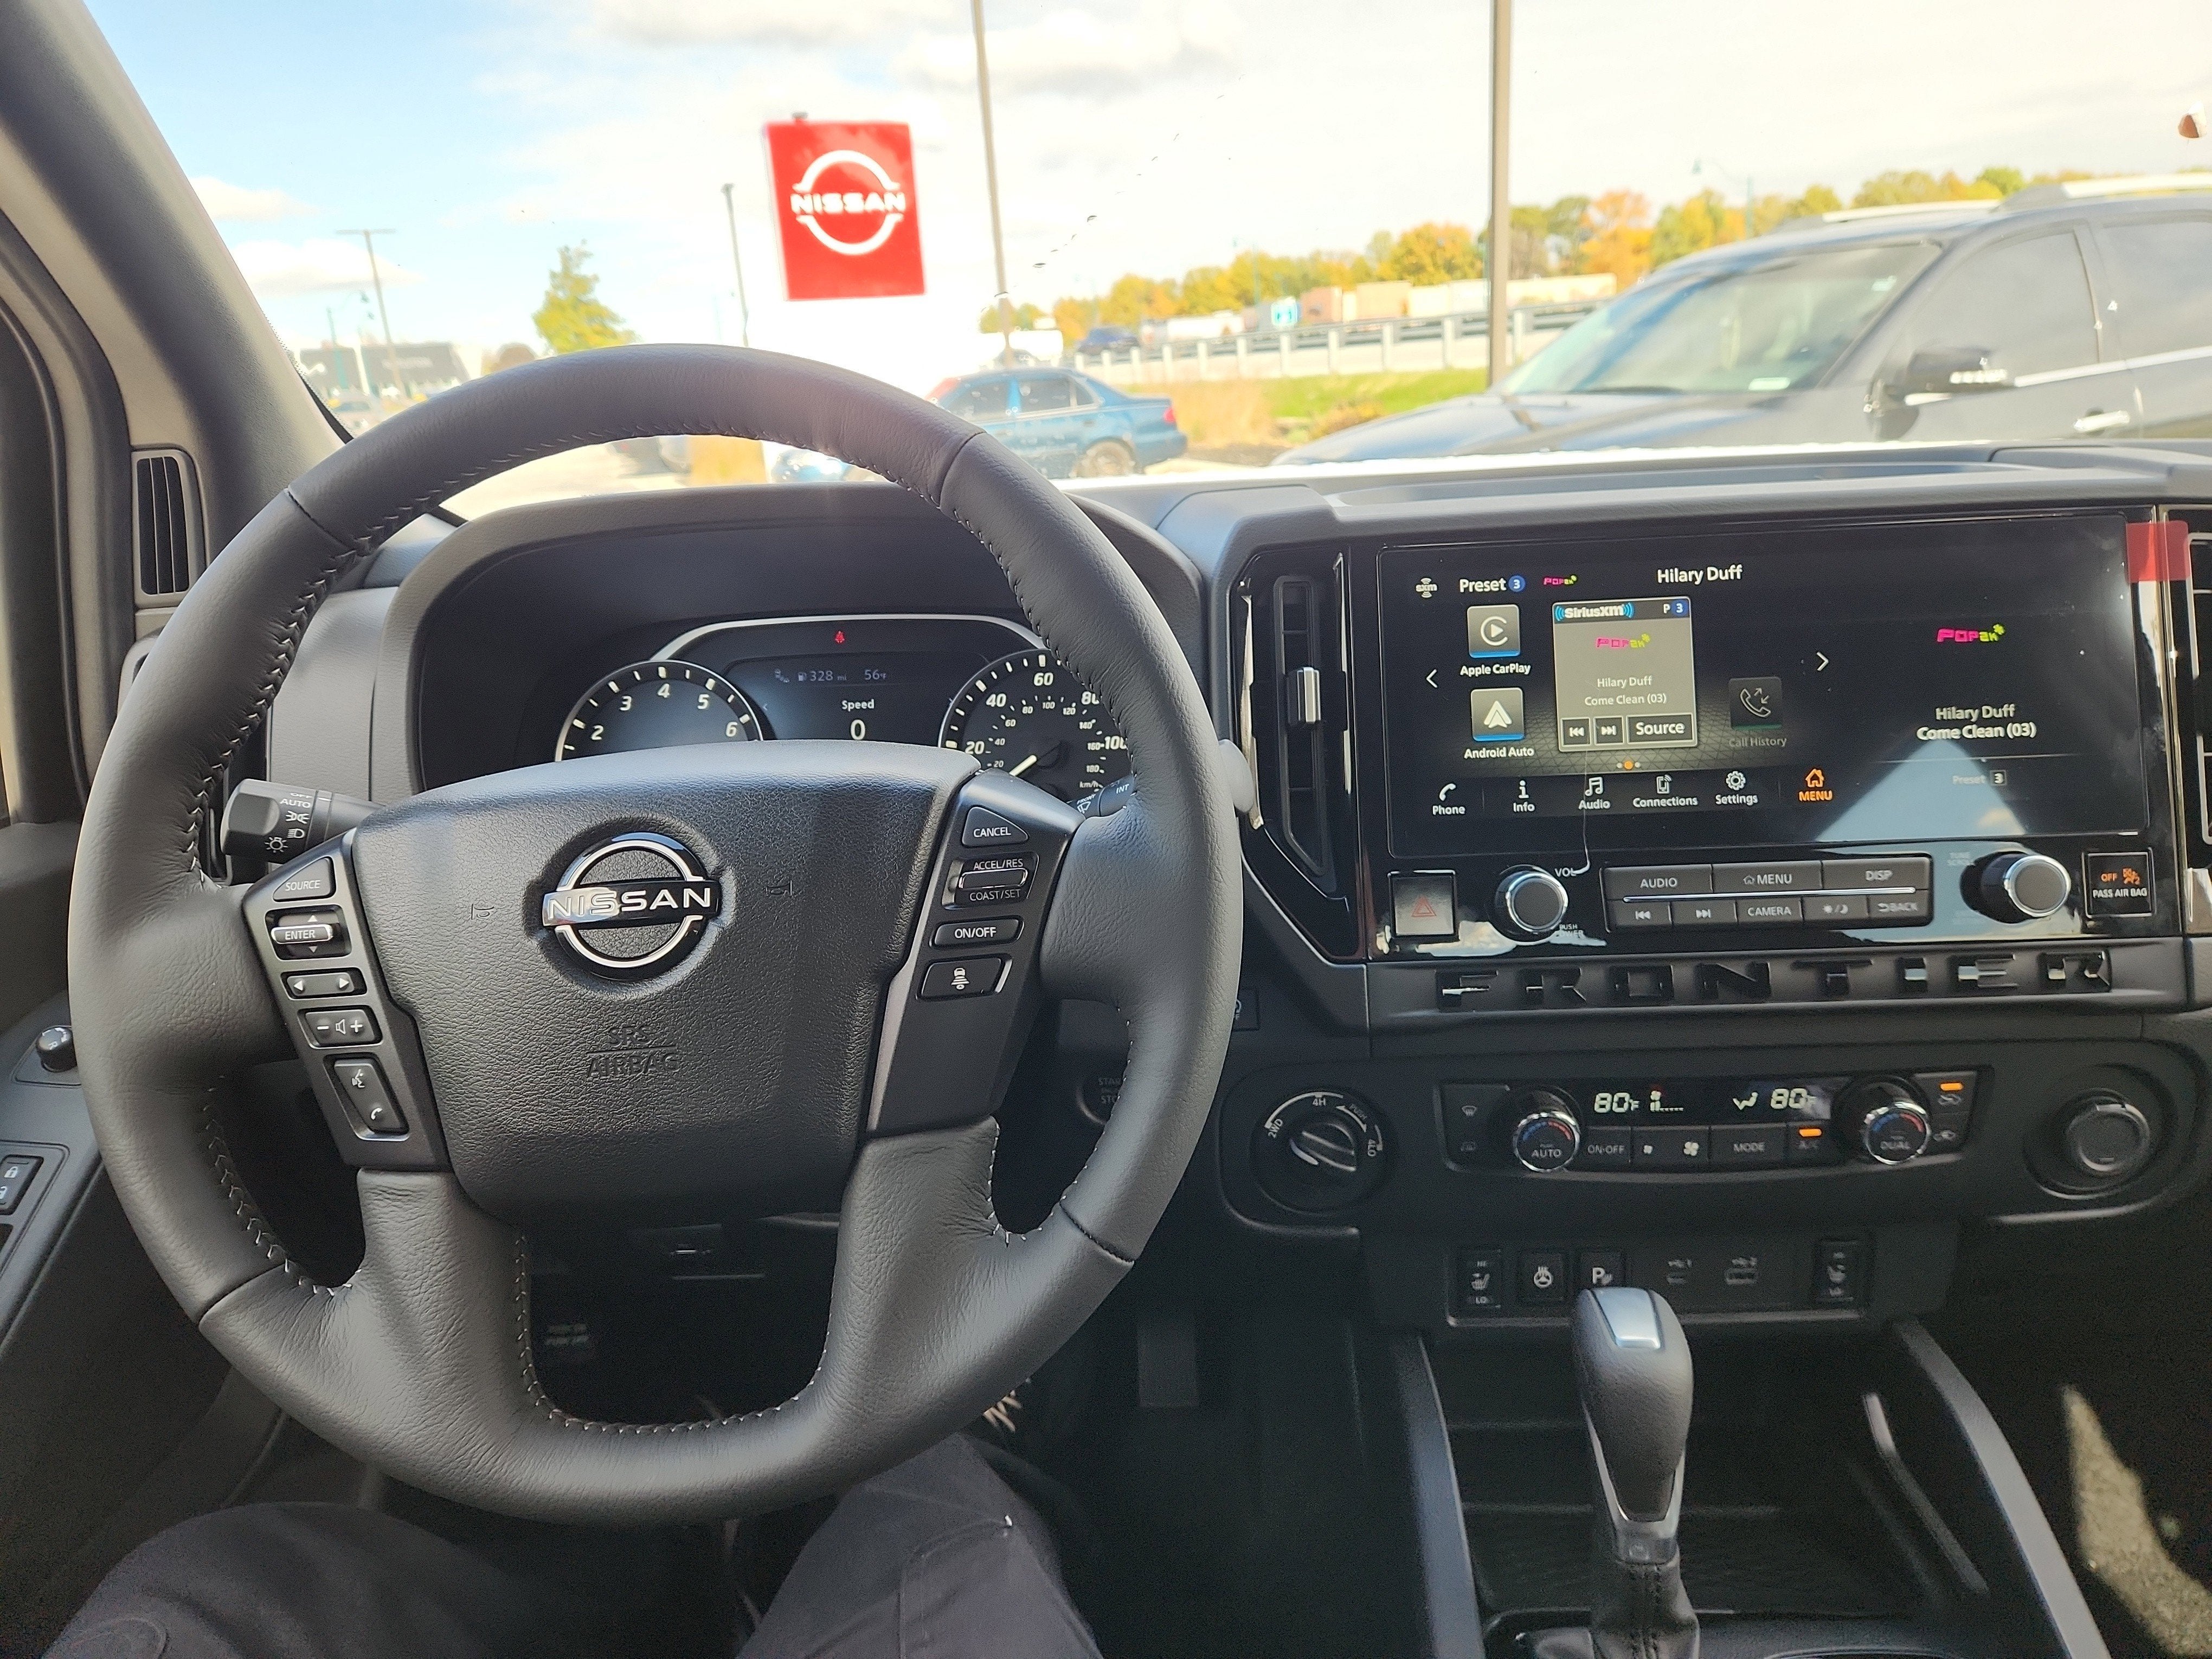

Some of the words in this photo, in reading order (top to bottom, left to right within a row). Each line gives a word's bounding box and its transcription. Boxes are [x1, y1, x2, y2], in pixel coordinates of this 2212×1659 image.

[790, 192, 905, 214] NISSAN
[1657, 567, 1703, 585] Hilary
[1707, 564, 1742, 581] Duff
[1459, 578, 1506, 593] Preset
[1663, 603, 1670, 614] P
[810, 670, 833, 681] 328
[1460, 664, 1491, 677] Apple
[1493, 663, 1531, 675] CarPlay
[1033, 672, 1053, 686] 60
[1597, 678, 1626, 689] Hilary
[1629, 675, 1652, 686] Duff
[657, 683, 670, 698] 4
[620, 696, 632, 711] 3
[697, 693, 710, 710] 5
[841, 698, 874, 712] Speed
[986, 693, 1007, 708] 40
[1042, 701, 1056, 709] 100
[1585, 697, 1613, 705] Come
[1616, 695, 1645, 704] Clean
[1647, 693, 1667, 704] (03)
[1063, 707, 1076, 715] 120
[1935, 708, 1978, 722] Hilary
[1982, 704, 2015, 718] Duff
[1005, 719, 1016, 727] 60
[1636, 722, 1685, 736] Source
[591, 724, 604, 741] 2
[725, 721, 737, 738] 6
[850, 719, 866, 741] 0
[1917, 727, 1962, 740] Come
[1963, 725, 2004, 739] Clean
[2007, 723, 2037, 738] (03)
[964, 741, 985, 755] 20
[1750, 736, 1787, 748] History
[1464, 747, 1507, 758] Android
[1508, 747, 1535, 757] Auto
[1994, 773, 2004, 784] 3
[1116, 784, 1130, 794] INT
[1633, 796, 1697, 808] Connections
[1715, 793, 1758, 806] Settings
[1799, 790, 1832, 802] MENU
[280, 798, 311, 808] AUTO
[1513, 802, 1535, 812] Info
[1579, 799, 1610, 810] Audio
[1432, 805, 1465, 815] Phone
[973, 826, 1012, 838] CANCEL
[973, 858, 1024, 870] ACCEL/RES
[1554, 867, 1577, 877] VOL
[285, 879, 320, 891] SOURCE
[1640, 878, 1677, 888] AUDIO
[1757, 874, 1792, 885] MENU
[969, 888, 1021, 901] COAST/SET
[2093, 889, 2113, 898] PASS
[548, 888, 711, 919] NISSAN
[1747, 906, 1791, 917] CAMERA
[285, 929, 316, 941] ENTER
[954, 926, 996, 938] ON/OFF
[1312, 1098, 1326, 1107] 4H
[1532, 1149, 1562, 1159] AUTO
